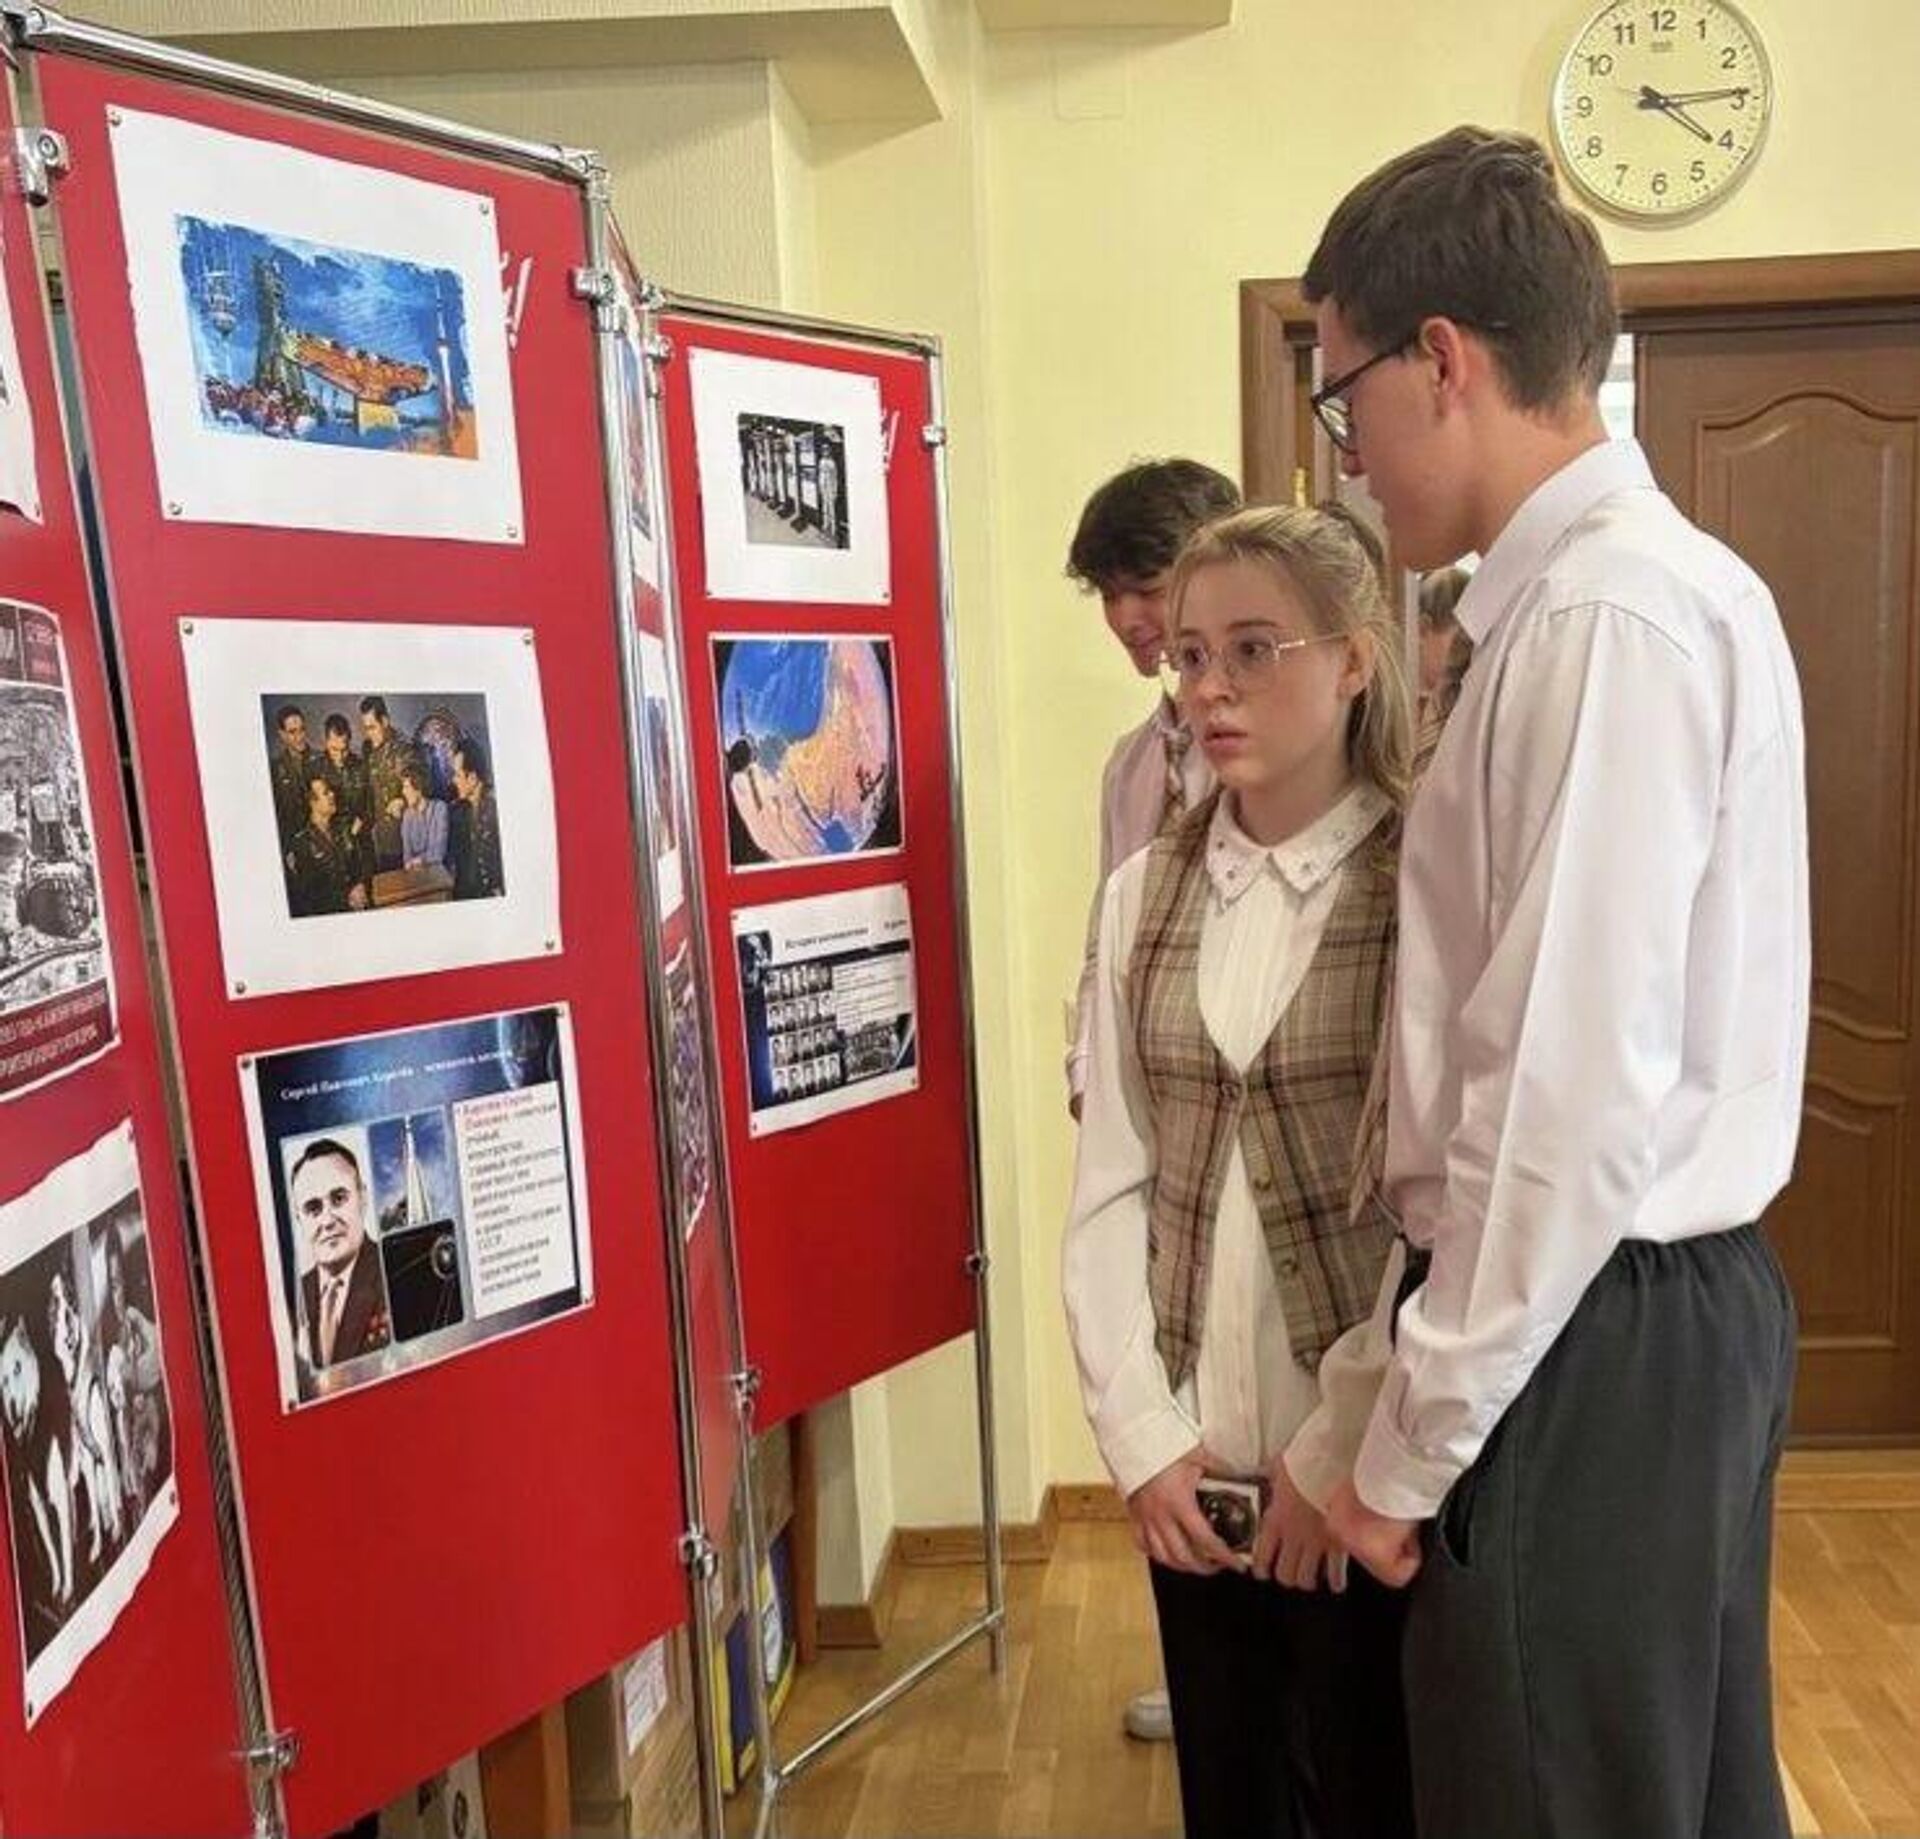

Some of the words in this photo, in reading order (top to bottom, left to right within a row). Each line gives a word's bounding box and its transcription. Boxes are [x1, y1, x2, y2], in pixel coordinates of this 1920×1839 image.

[1650, 10, 1677, 31] 12
[1697, 18, 1706, 40] 1
[1614, 22, 1636, 45] 11
[1587, 54, 1613, 76] 10
[1721, 47, 1737, 69] 2
[1577, 96, 1593, 118] 9
[1730, 88, 1745, 110] 3
[1586, 136, 1602, 158] 8
[1718, 130, 1734, 151] 4
[1616, 164, 1629, 186] 7
[1690, 161, 1706, 182] 5
[1652, 174, 1668, 195] 6
